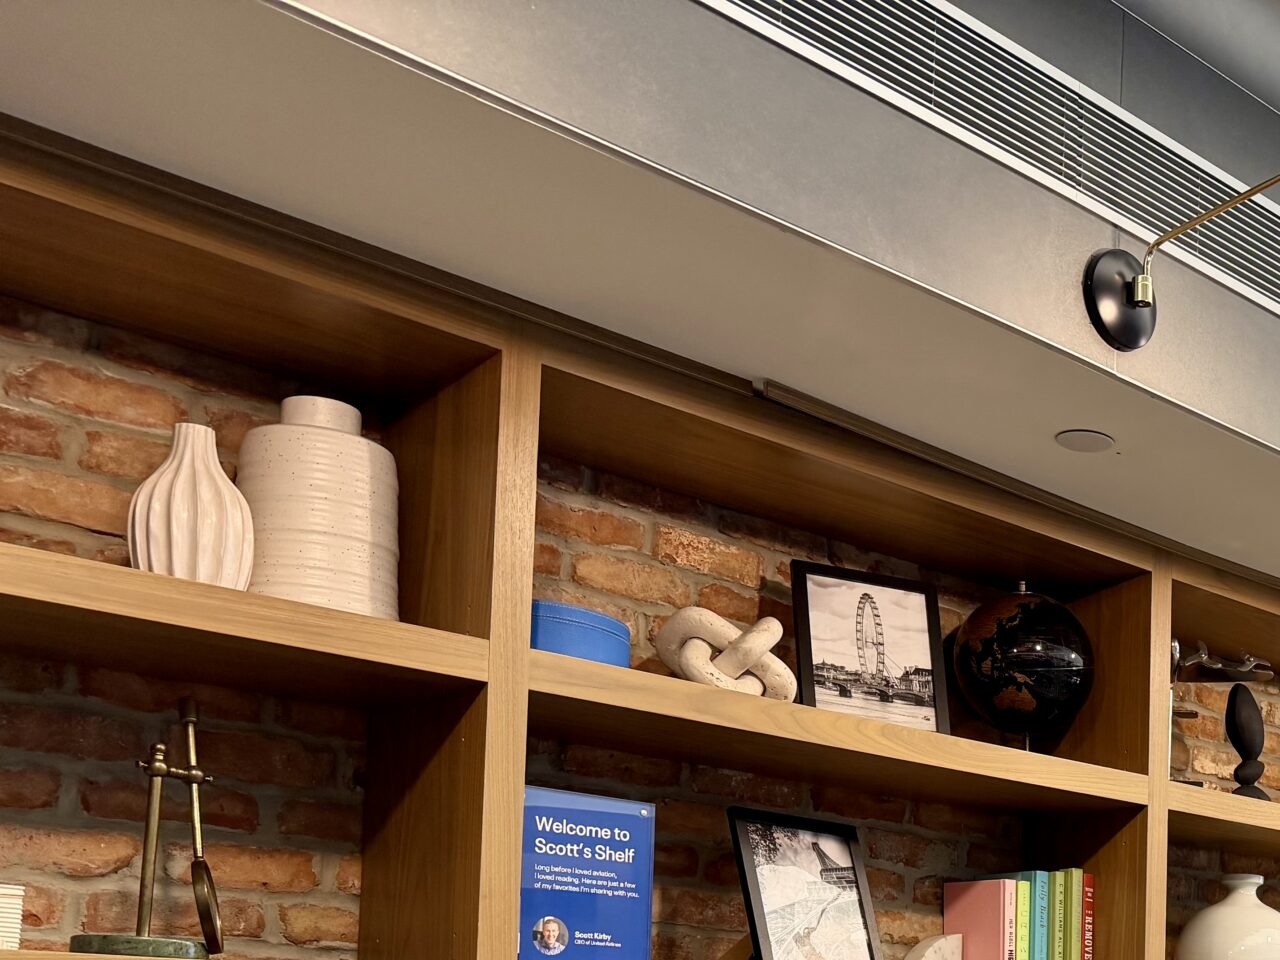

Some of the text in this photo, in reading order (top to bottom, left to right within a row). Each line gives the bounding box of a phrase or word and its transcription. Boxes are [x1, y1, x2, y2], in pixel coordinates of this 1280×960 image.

[535, 816, 630, 841] Welcome to
[535, 838, 635, 863] Scott's Shelf
[535, 864, 550, 872] Long
[593, 870, 617, 878] aviation,
[556, 875, 580, 884] reading.
[553, 884, 579, 892] favorites
[591, 888, 612, 896] sharing
[1038, 881, 1047, 900] Folly
[575, 931, 611, 941] Scott Kirby
